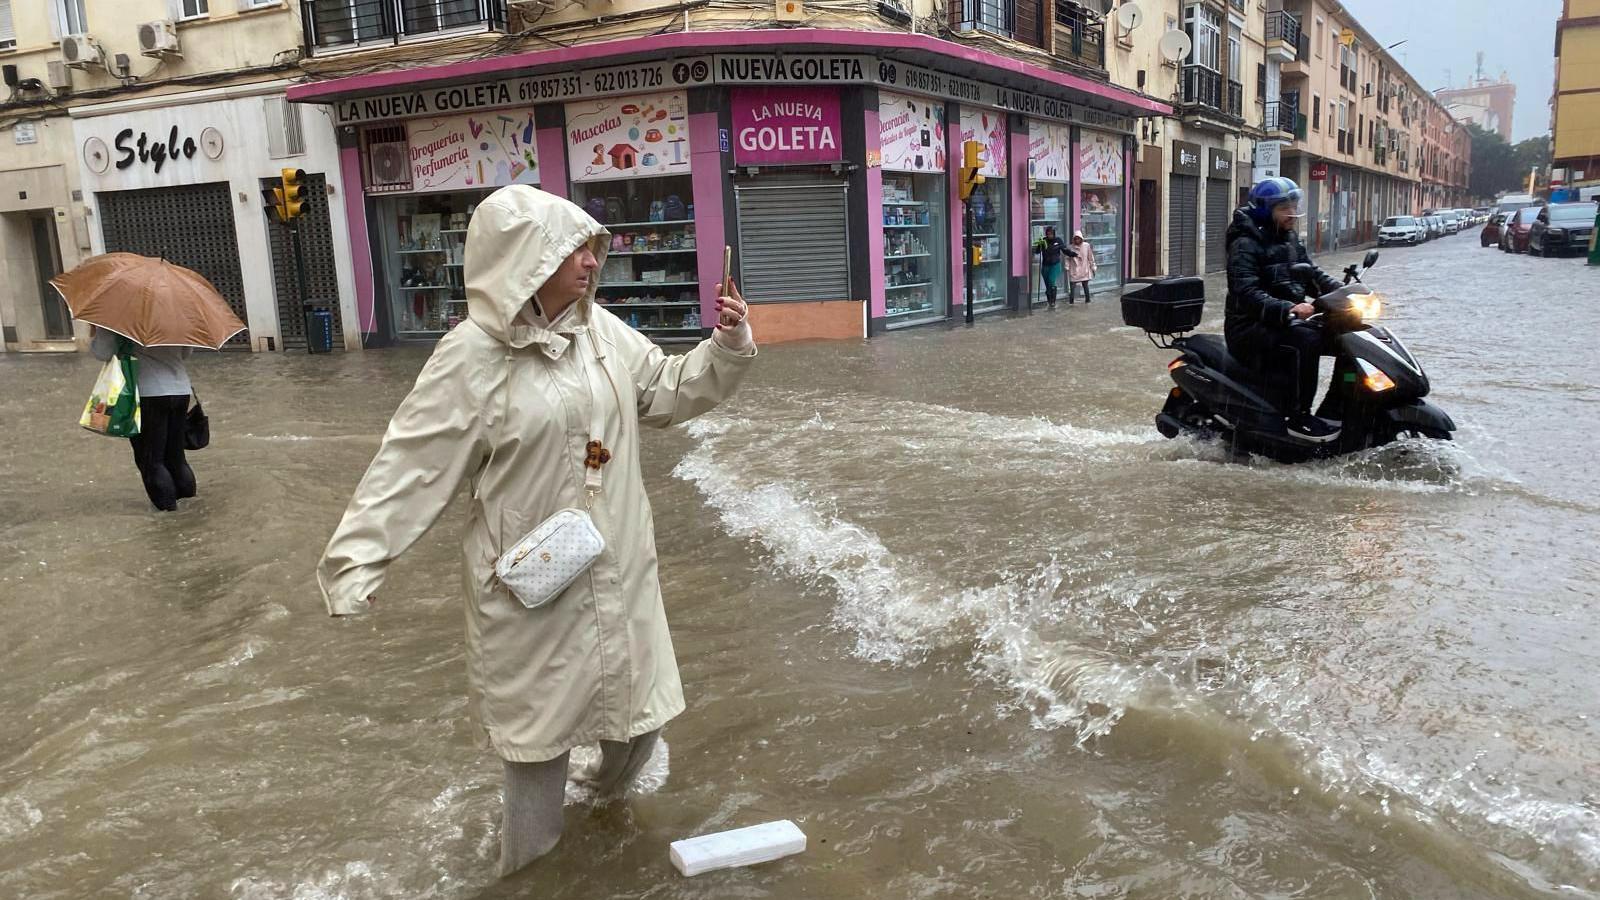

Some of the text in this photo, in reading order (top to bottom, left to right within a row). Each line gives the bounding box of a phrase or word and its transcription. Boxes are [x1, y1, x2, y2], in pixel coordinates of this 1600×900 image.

[721, 58, 864, 80] NUEVA GOLETA
[338, 102, 361, 122] LA
[366, 94, 427, 118] NUEVA
[435, 83, 512, 111] GOLETA
[519, 80, 539, 100] 619
[540, 78, 560, 98] 857
[563, 75, 582, 96] 351
[594, 72, 615, 93] 622
[618, 69, 638, 90] 013
[641, 66, 663, 87] 726
[996, 88, 1009, 108] LA
[1012, 92, 1040, 114] NUEVA
[1044, 99, 1073, 120] GOLETA
[752, 102, 822, 122] LA NUEVA
[410, 130, 460, 161] Droguería
[570, 116, 622, 145] Mascotas
[739, 126, 836, 151] GOLETA
[115, 125, 197, 174] Stylo
[414, 147, 469, 178] Perfumería
